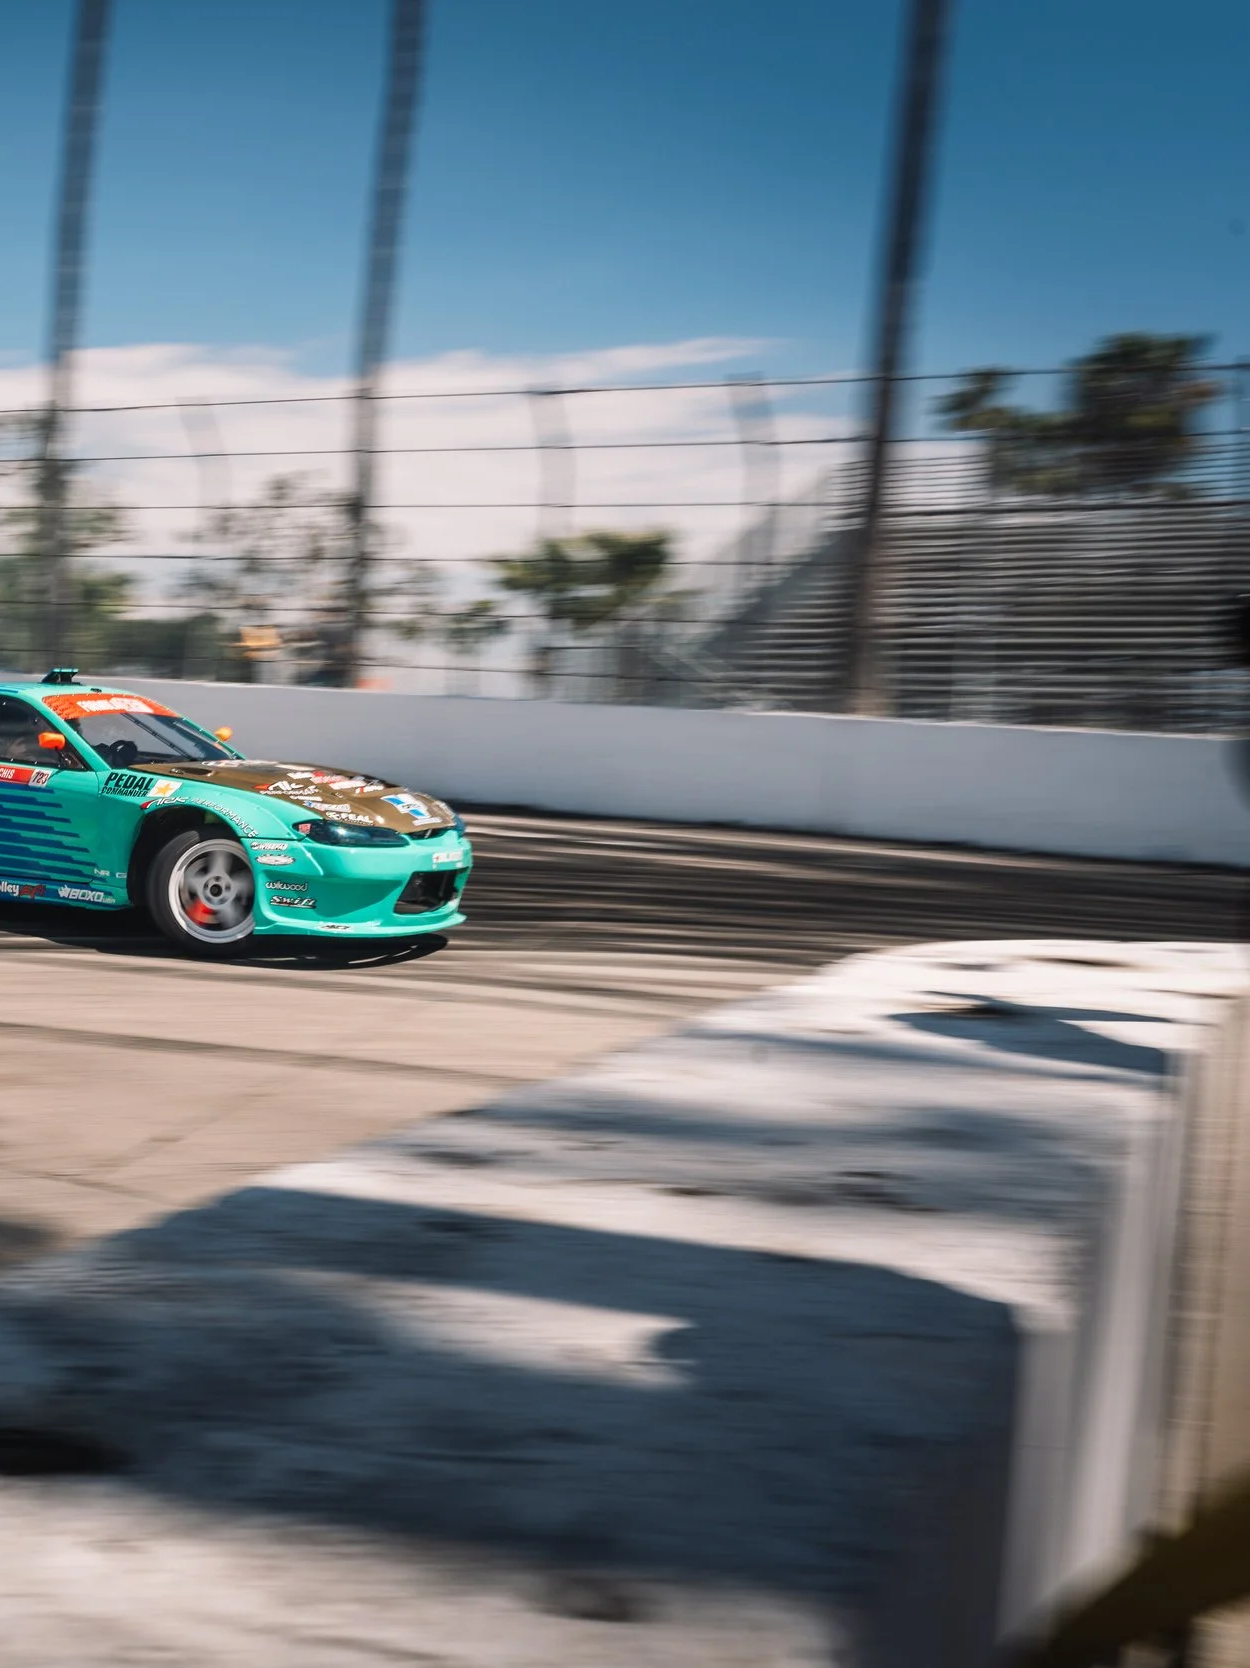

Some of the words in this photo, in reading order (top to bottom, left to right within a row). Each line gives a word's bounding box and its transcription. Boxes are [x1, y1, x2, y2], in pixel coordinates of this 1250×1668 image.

[32, 770, 50, 785] 123
[104, 772, 154, 791] PEDAL
[101, 786, 149, 798] COMMANDER
[265, 881, 308, 892] wilwood
[68, 888, 104, 903] BOXO
[271, 895, 315, 907] Swift
